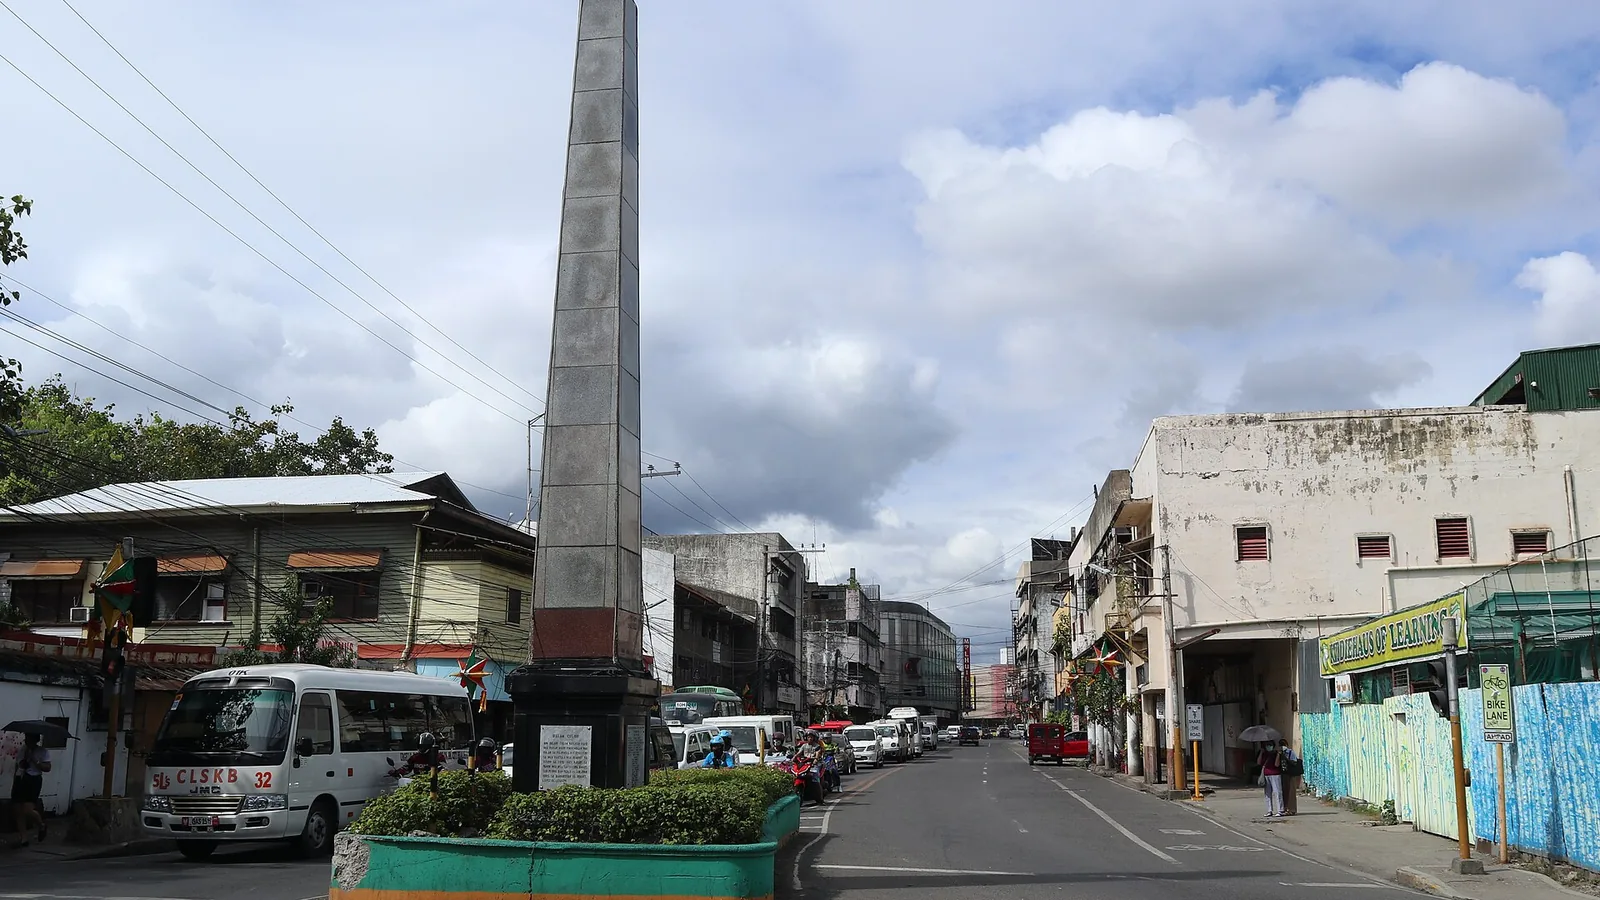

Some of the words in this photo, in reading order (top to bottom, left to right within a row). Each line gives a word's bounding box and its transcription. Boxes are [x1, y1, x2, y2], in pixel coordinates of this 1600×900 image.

[1375, 625, 1387, 654] OF
[1486, 700, 1506, 709] BIKE
[1486, 711, 1508, 720] LANE
[254, 771, 272, 789] 32
[190, 785, 221, 794] JMC
